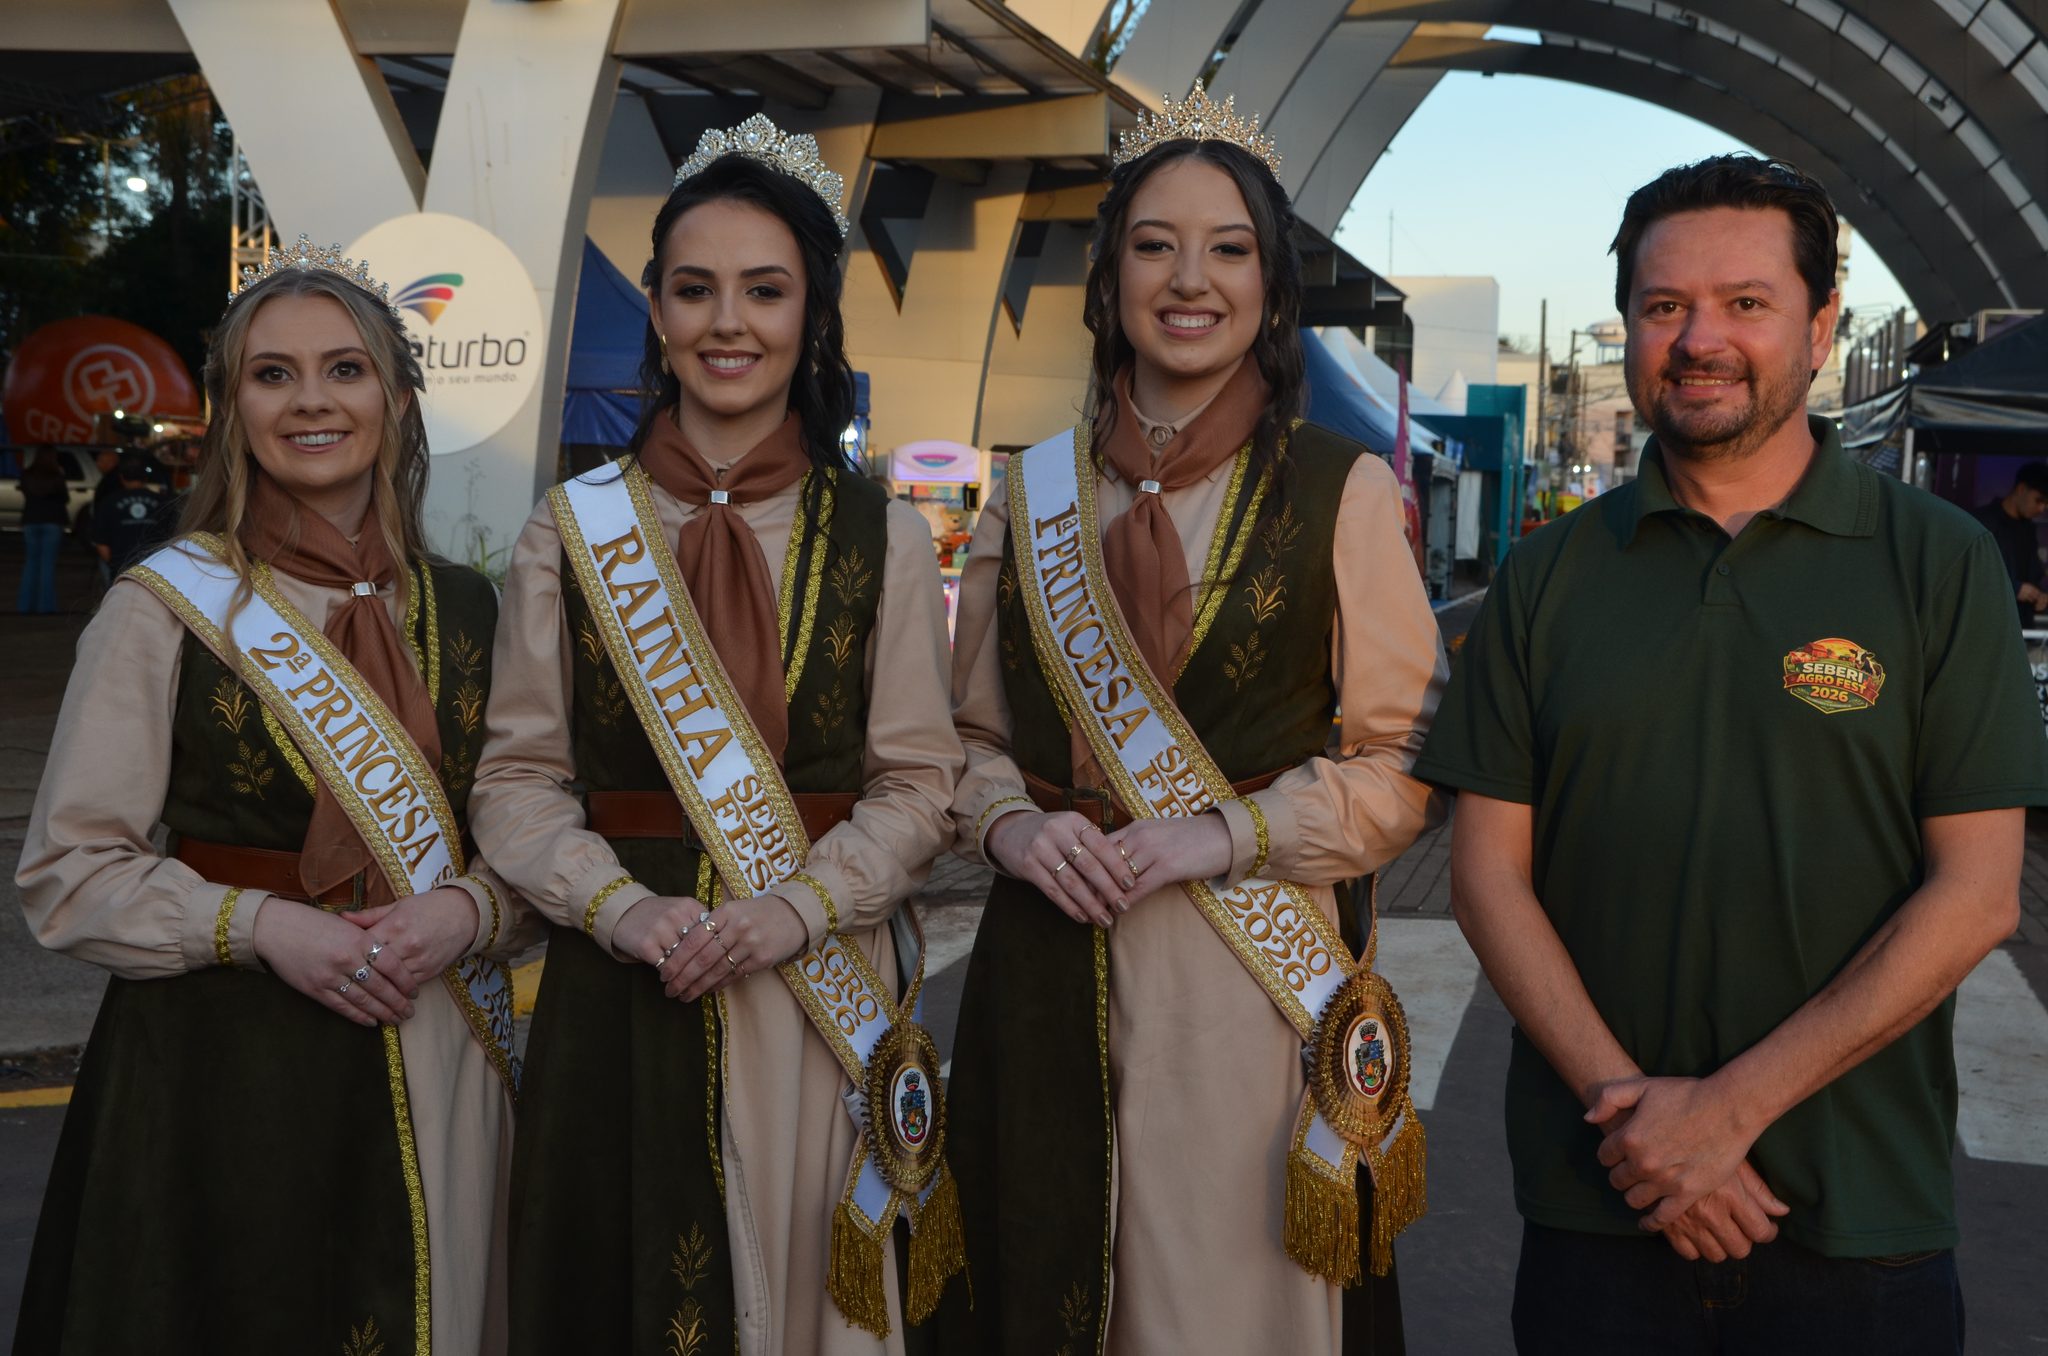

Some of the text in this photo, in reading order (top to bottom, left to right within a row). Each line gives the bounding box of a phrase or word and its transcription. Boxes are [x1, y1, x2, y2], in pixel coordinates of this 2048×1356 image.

[25, 408, 97, 445] CRE
[409, 333, 526, 369] êturbo
[449, 375, 470, 385] seu
[591, 524, 734, 780] RAINHA
[1037, 530, 1151, 751] PRINCESA
[1796, 673, 1867, 694] AGRO FEST
[1802, 662, 1864, 683] SEBERI
[1810, 685, 1849, 702] 2026
[248, 632, 440, 875] 2ª PRINCESA
[1154, 744, 1331, 976] SEB AGRO
[707, 787, 861, 1036] FES 026
[731, 774, 878, 1022] SEBE GRO
[1132, 759, 1311, 992] FE 2026
